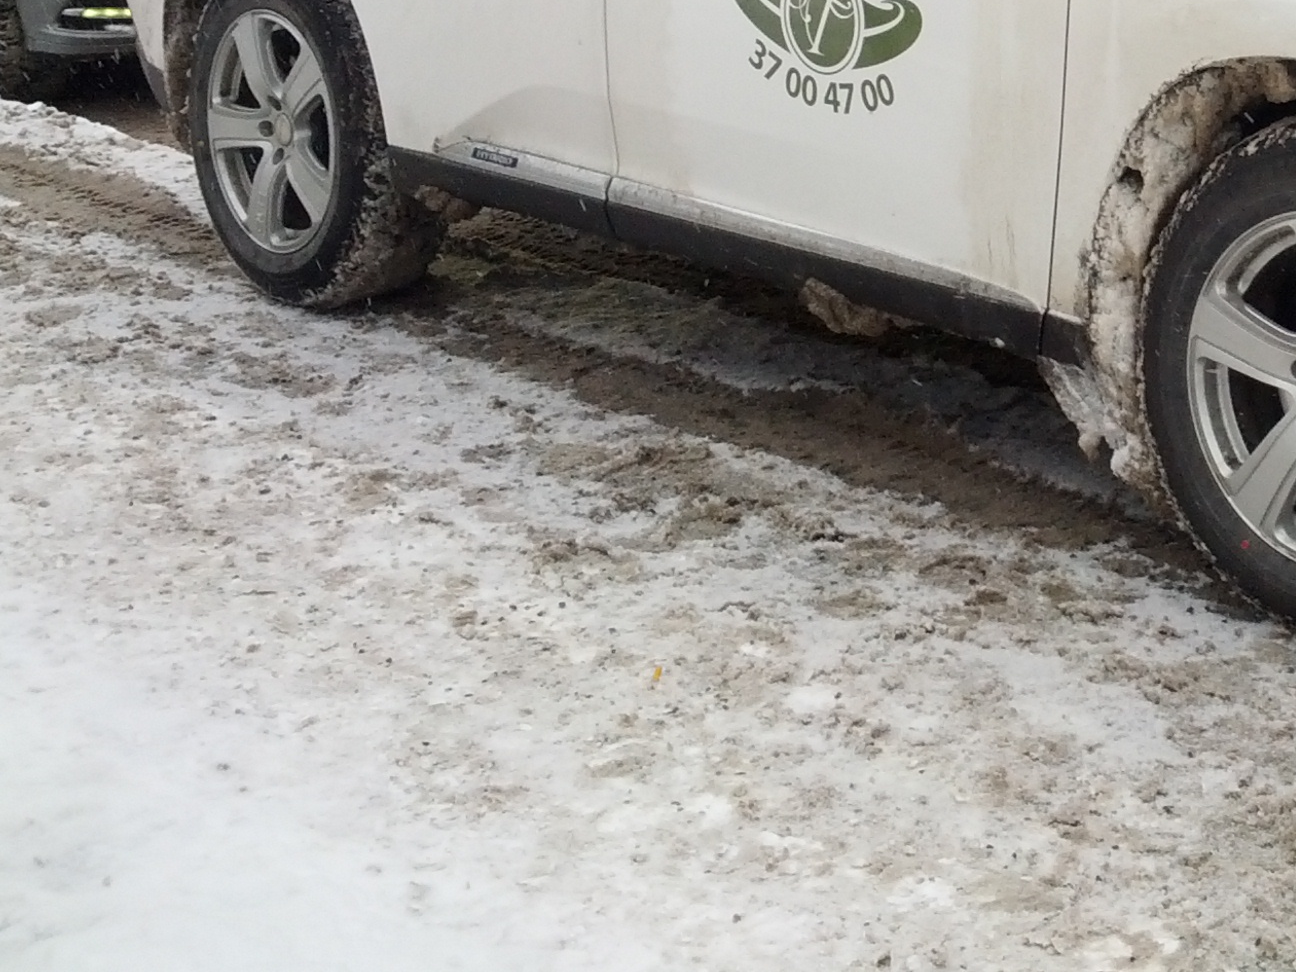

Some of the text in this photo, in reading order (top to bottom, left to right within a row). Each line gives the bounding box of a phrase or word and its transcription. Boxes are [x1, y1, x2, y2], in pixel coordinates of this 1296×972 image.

[748, 38, 894, 114] 37 00 47 00
